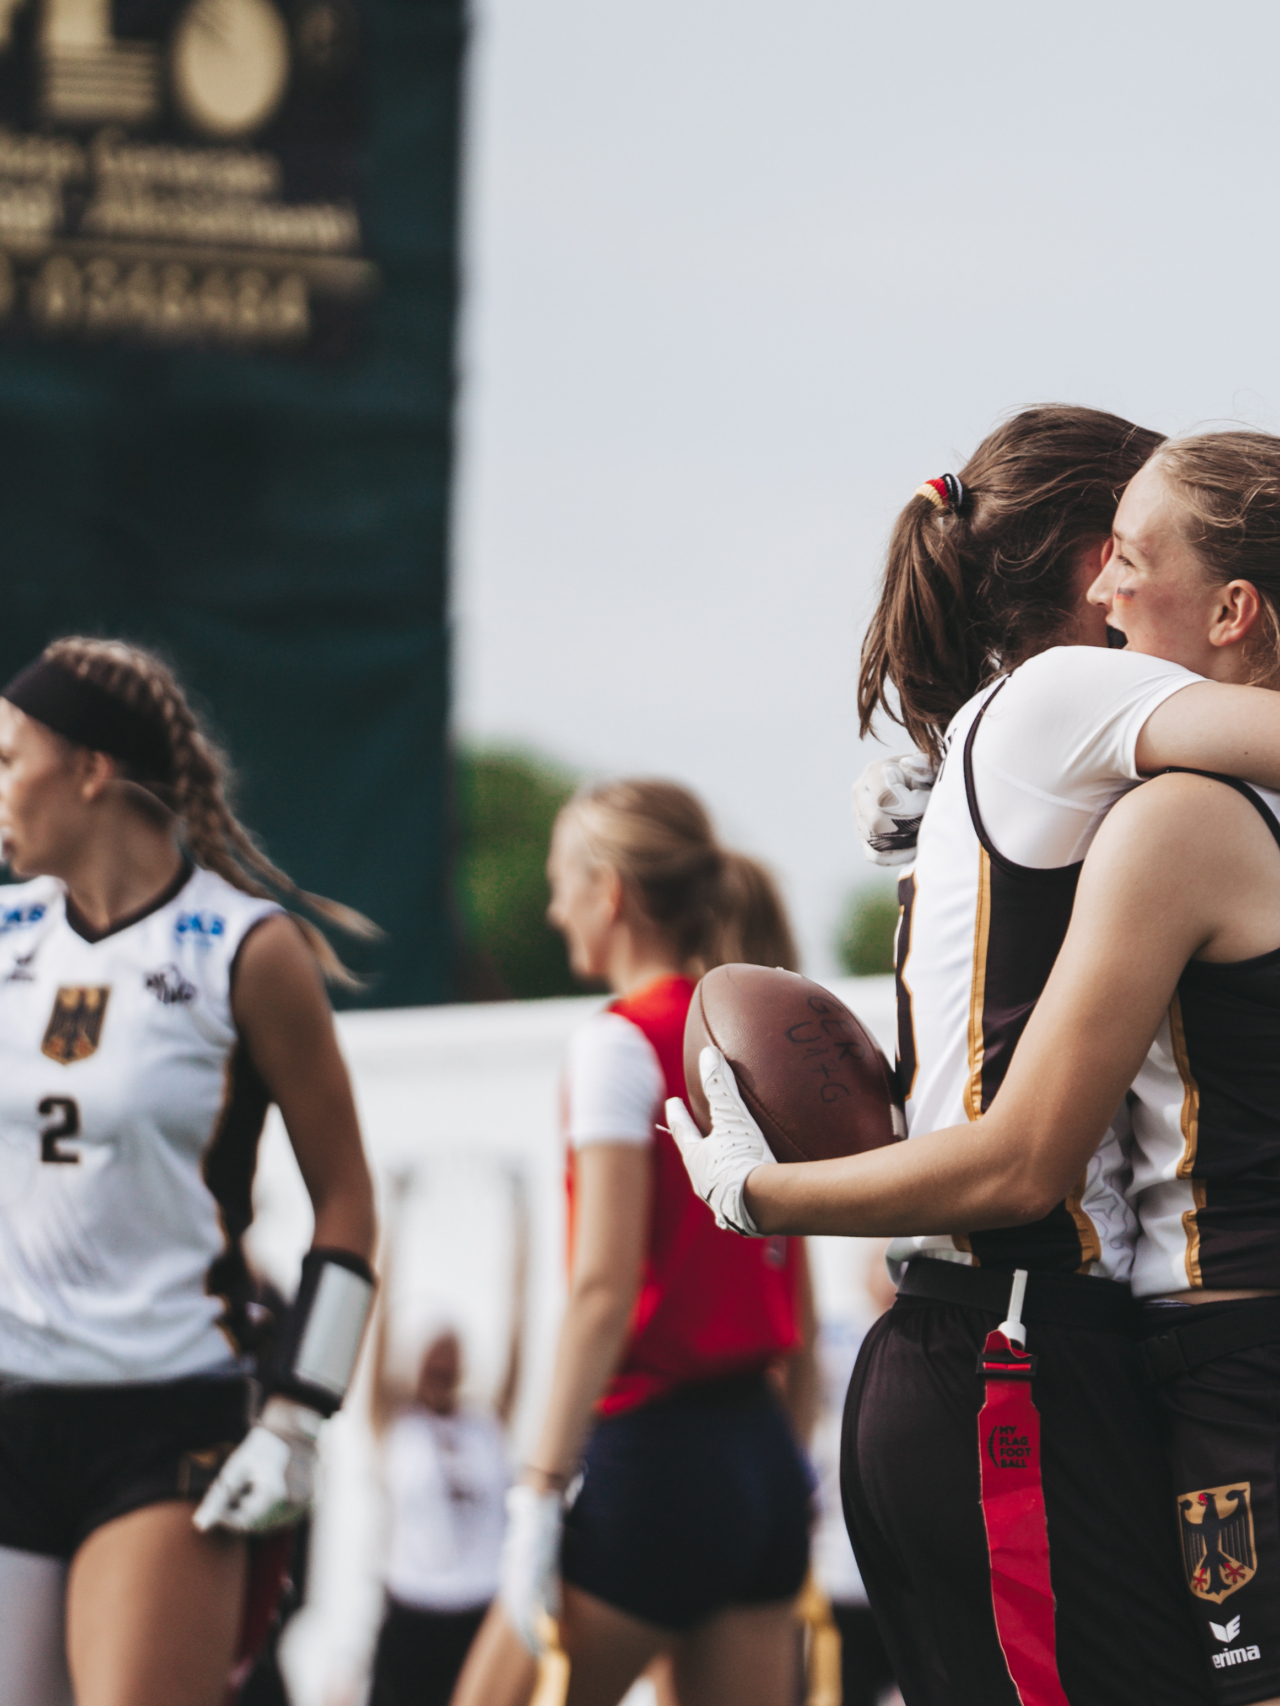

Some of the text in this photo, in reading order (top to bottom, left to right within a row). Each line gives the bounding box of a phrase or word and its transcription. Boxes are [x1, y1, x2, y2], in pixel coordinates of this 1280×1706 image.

[37, 1095, 81, 1164] 2
[999, 1425, 1017, 1435] MY
[999, 1436, 1029, 1446] FLAG
[1000, 1447, 1032, 1458] FOOT
[1000, 1459, 1028, 1469] BALL
[1211, 1644, 1262, 1669] erima
